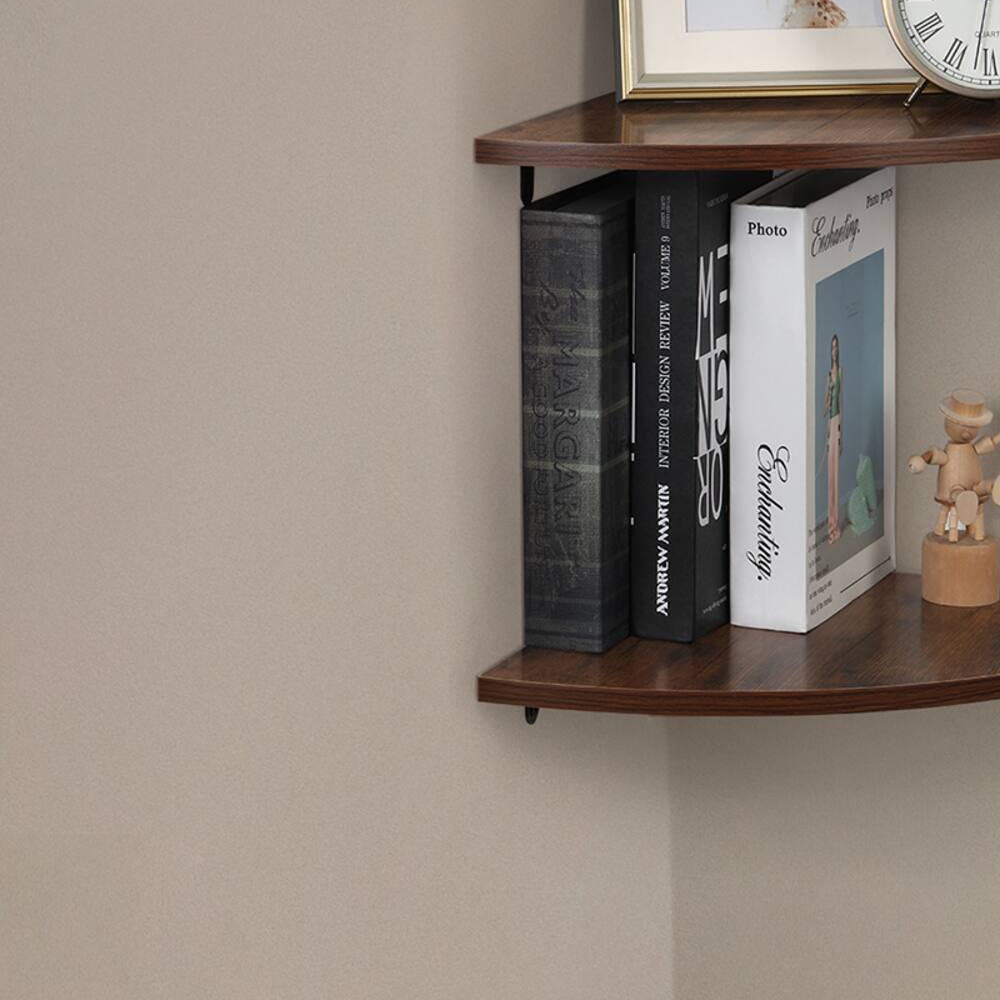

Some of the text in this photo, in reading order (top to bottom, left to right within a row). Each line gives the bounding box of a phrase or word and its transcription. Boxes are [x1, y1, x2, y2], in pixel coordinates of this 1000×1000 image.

[914, 12, 944, 43] VIII
[943, 38, 968, 71] VII
[983, 48, 998, 76] VI
[747, 222, 788, 237] Photo
[660, 244, 671, 290] VOLUME
[660, 300, 671, 349] REVIEW
[658, 355, 670, 402] DESIGN
[658, 408, 670, 469] INTERIOR
[745, 444, 791, 581] Enchanting.
[656, 483, 670, 616] ANDREW MARTIN
